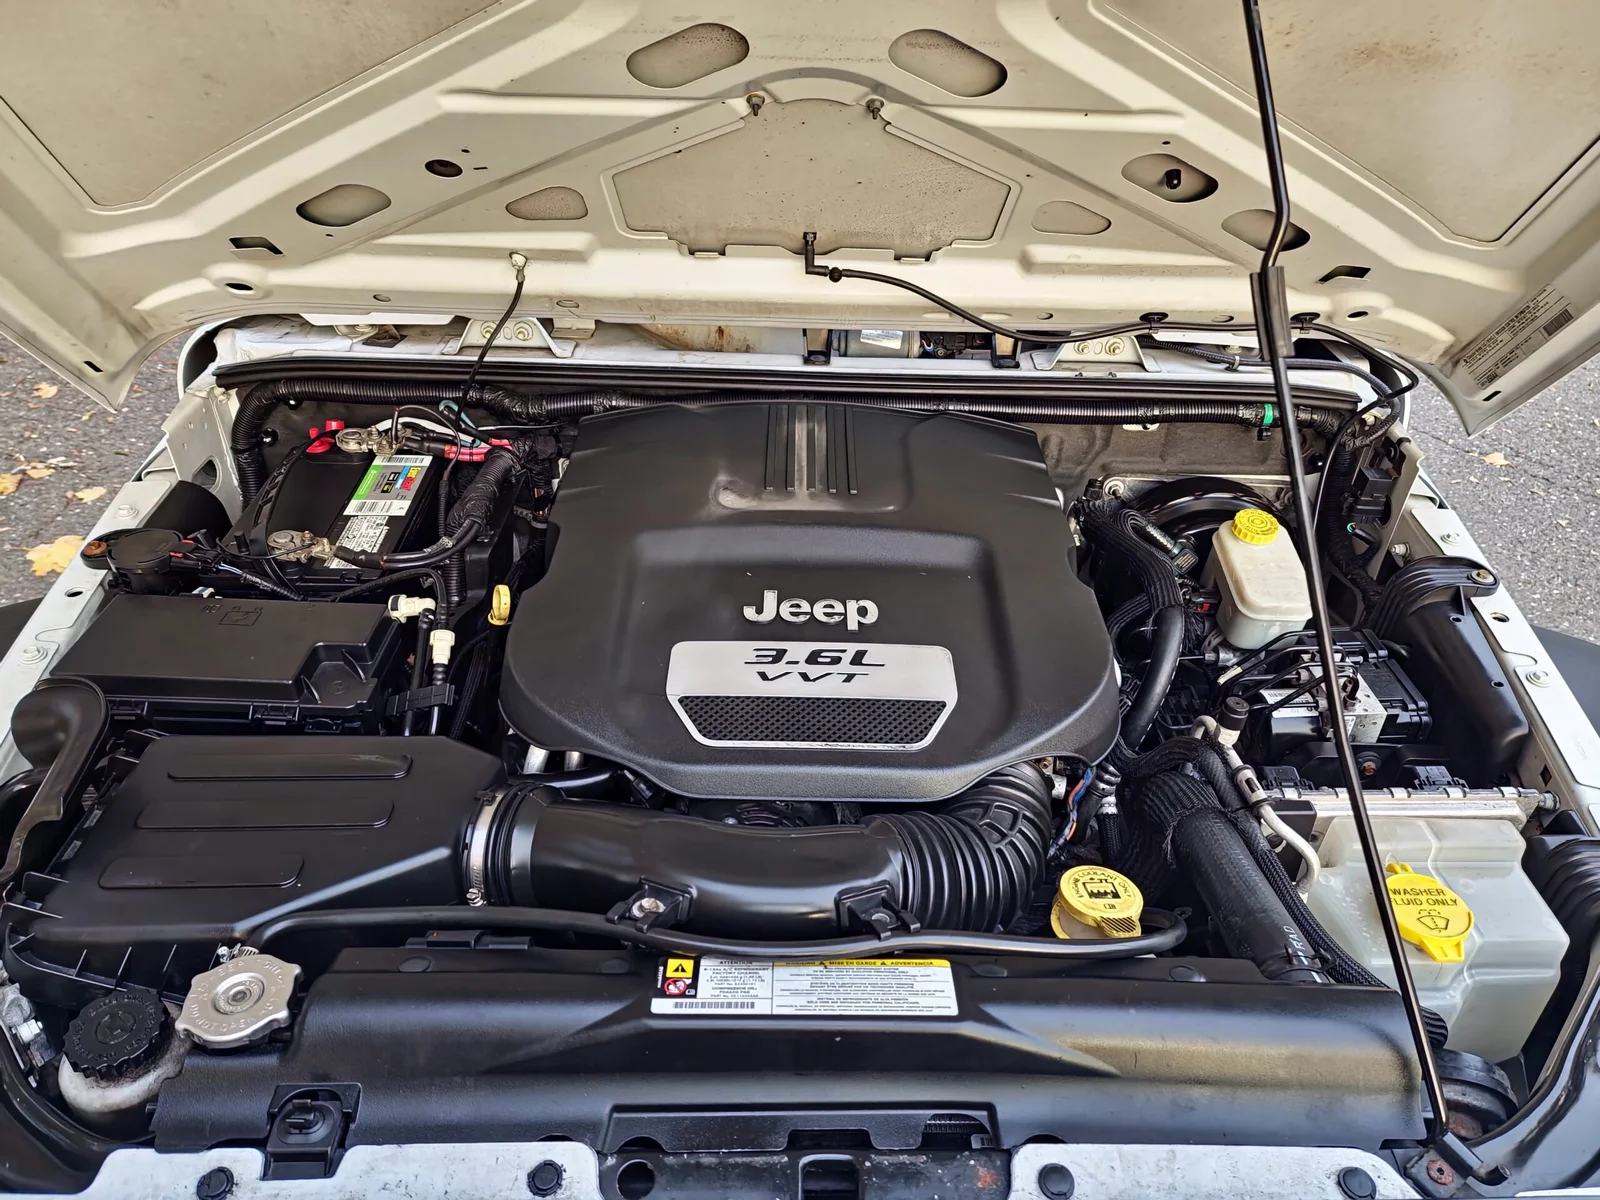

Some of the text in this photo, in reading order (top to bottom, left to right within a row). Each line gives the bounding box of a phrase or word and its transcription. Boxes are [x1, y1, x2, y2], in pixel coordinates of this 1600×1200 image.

[743, 589, 879, 632] Jeep
[744, 648, 885, 667] 3.6L
[756, 671, 869, 683] VVT
[1389, 888, 1446, 896] WASHER
[1426, 898, 1458, 906] ONLY
[1283, 925, 1306, 951] RAD
